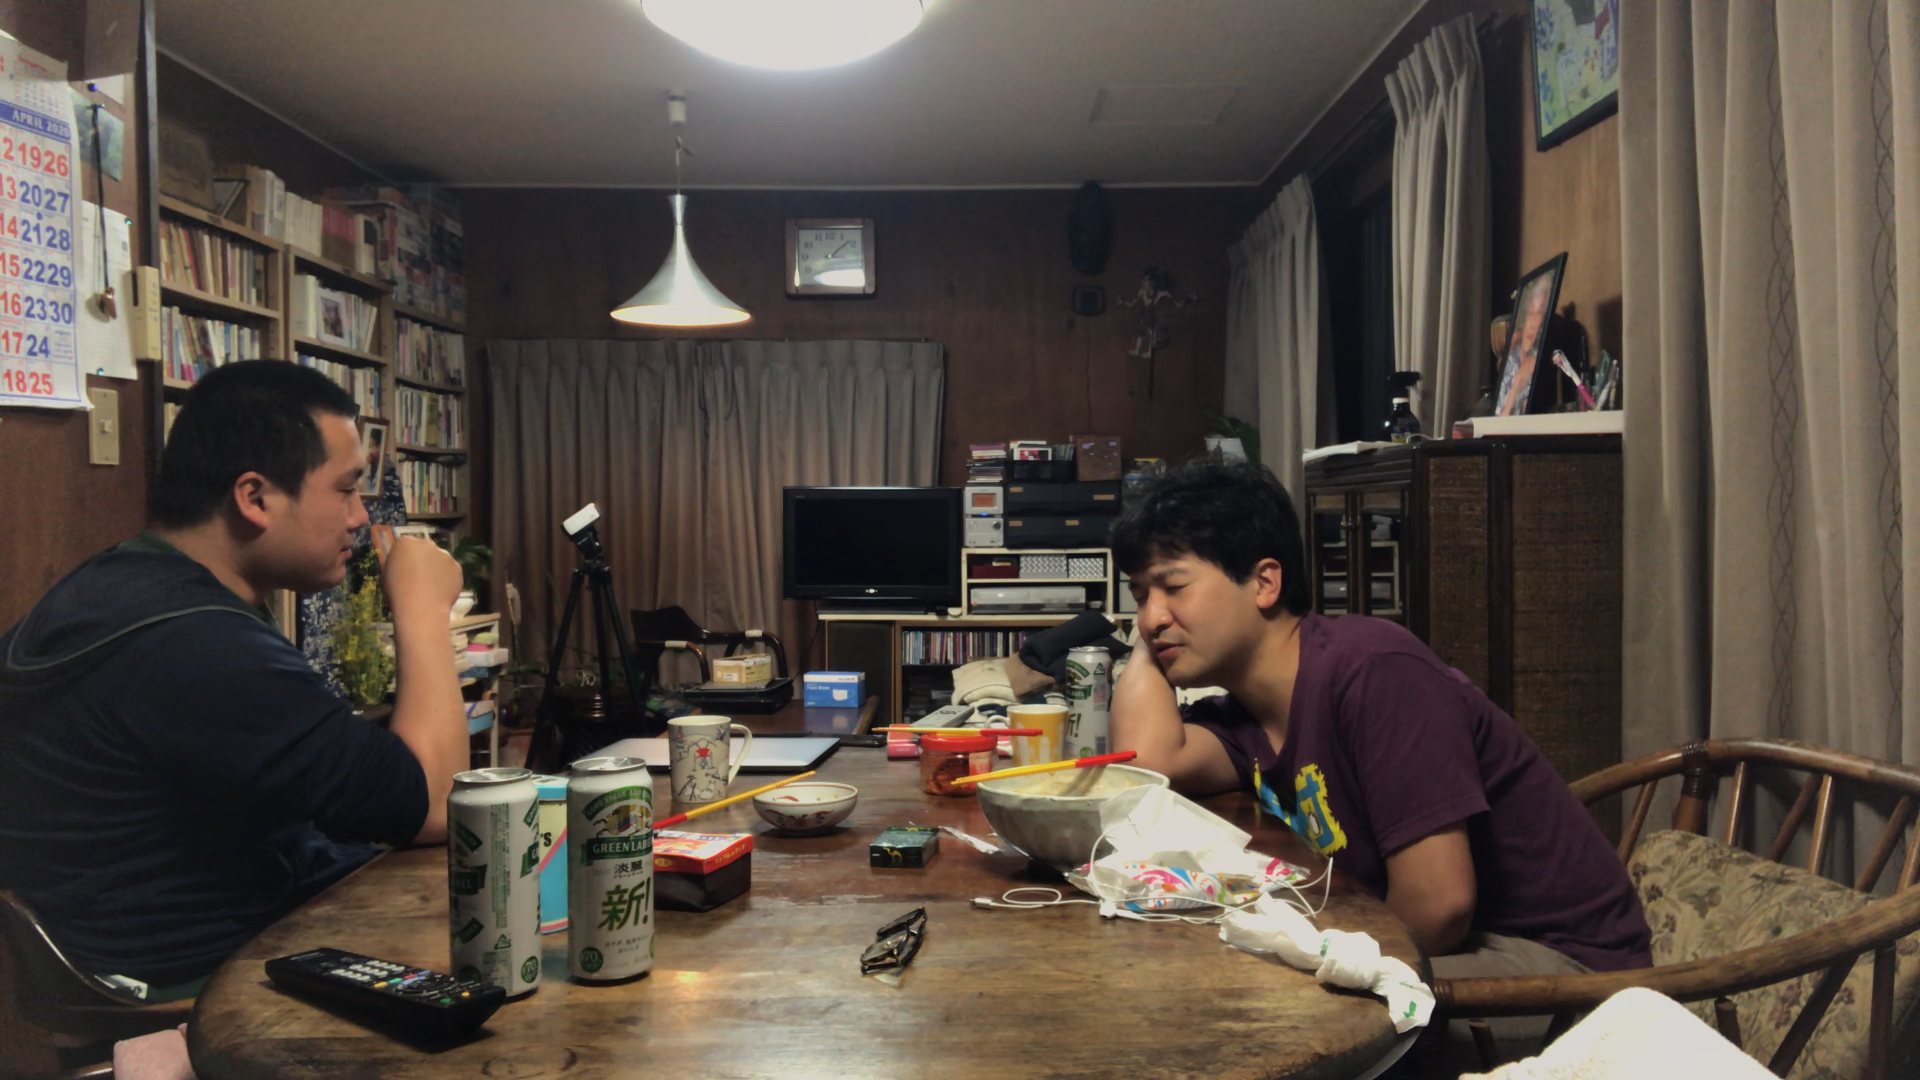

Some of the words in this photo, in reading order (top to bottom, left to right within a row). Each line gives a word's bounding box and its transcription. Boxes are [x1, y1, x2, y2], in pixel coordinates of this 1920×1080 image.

[12, 109, 43, 130] APRIL
[46, 120, 70, 137] 2020
[18, 142, 41, 169] 19
[43, 150, 69, 177] 26
[20, 180, 42, 207] 20
[44, 188, 69, 213] 27
[21, 219, 41, 245] 21
[45, 225, 70, 251] 28
[0, 252, 20, 277] 15
[23, 257, 45, 283] 22
[48, 263, 72, 288] 29
[0, 290, 21, 316] 16
[25, 295, 47, 320] 23
[49, 300, 73, 324] 30
[1, 330, 23, 354] 17
[27, 334, 50, 358] 24
[3, 368, 27, 393] 18
[29, 371, 54, 395] 25
[592, 842, 630, 854] GREEN
